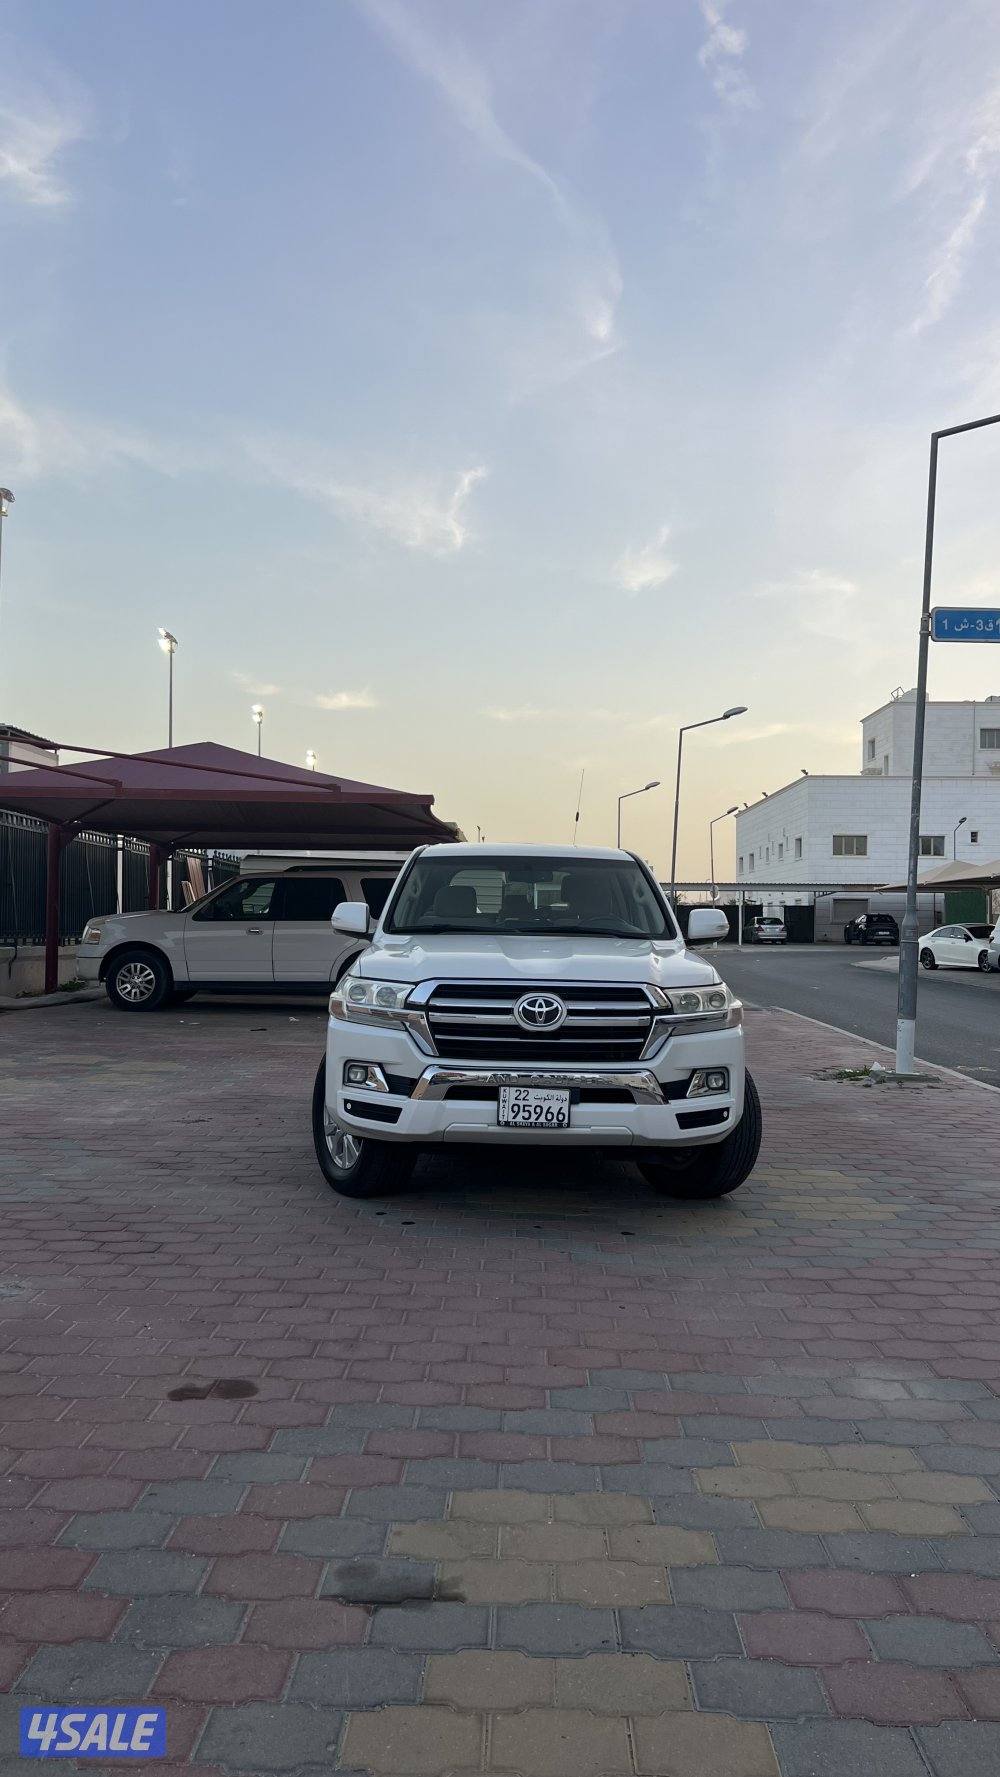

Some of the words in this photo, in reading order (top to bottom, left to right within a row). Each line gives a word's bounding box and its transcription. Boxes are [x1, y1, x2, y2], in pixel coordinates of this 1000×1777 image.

[942, 618, 948, 630] 1
[514, 1089, 530, 1101] 22
[533, 1094, 555, 1102] الكويت
[555, 1094, 568, 1104] دولة
[510, 1103, 566, 1123] 95966
